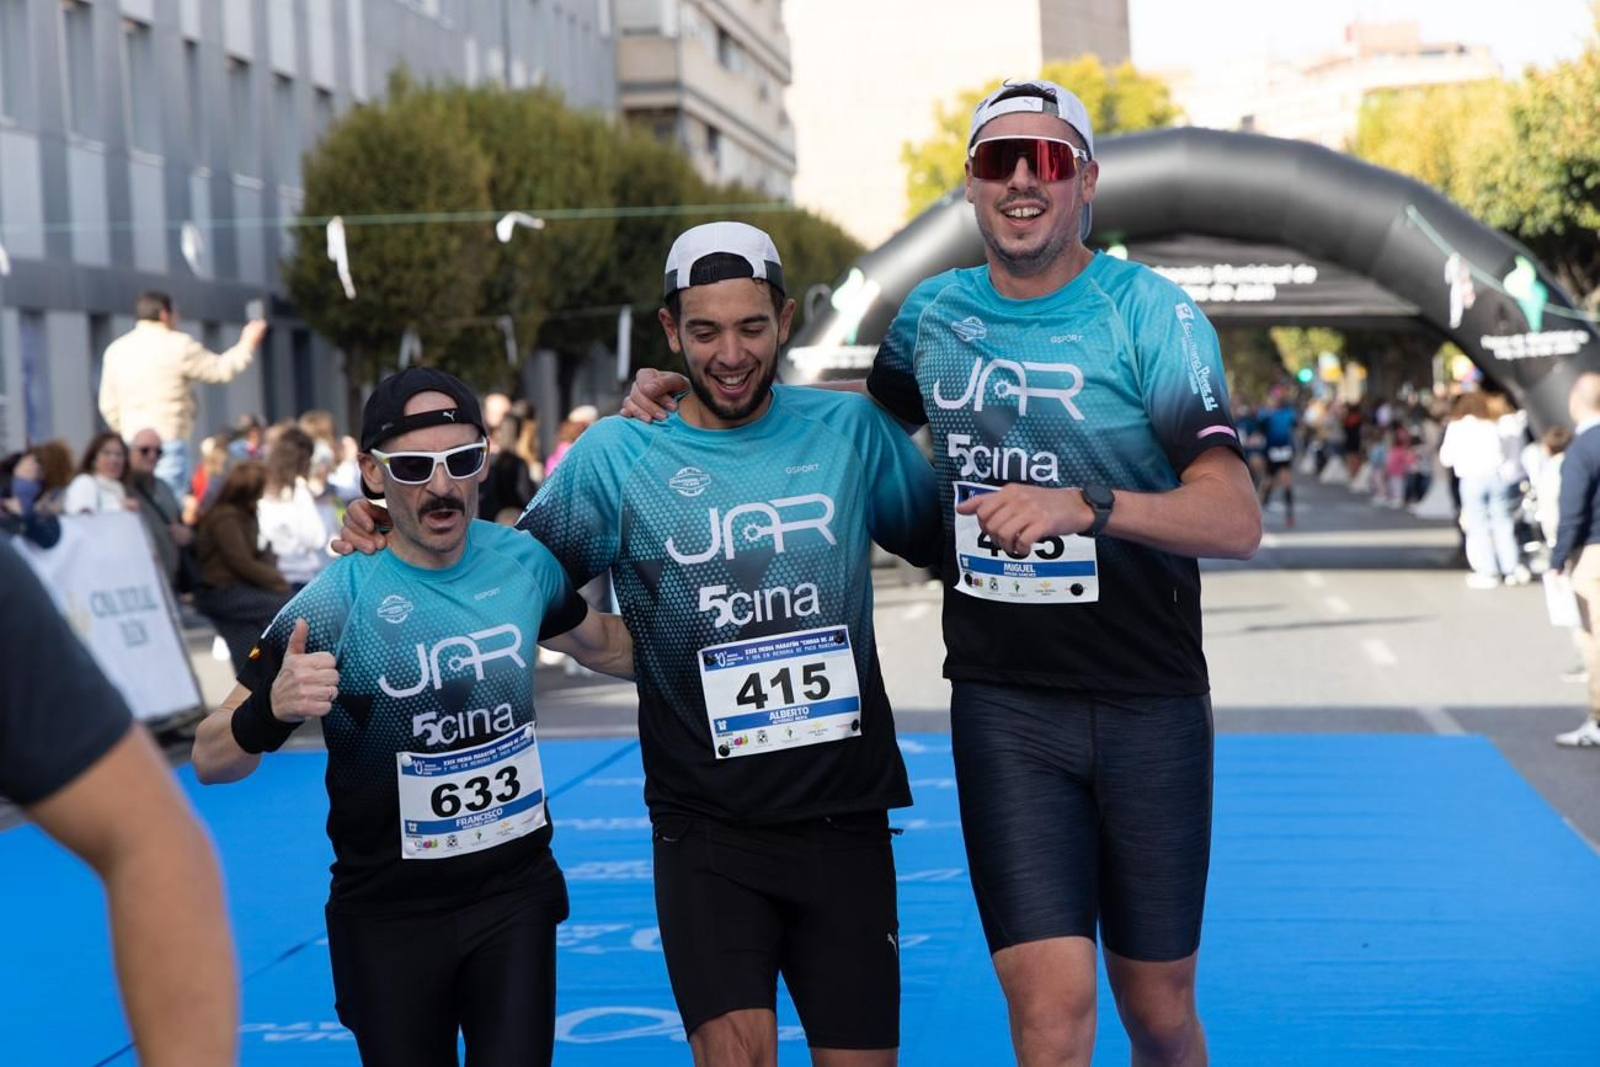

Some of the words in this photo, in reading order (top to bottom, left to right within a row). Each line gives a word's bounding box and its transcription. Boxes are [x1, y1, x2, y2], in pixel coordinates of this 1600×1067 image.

[933, 356, 1085, 421] JAR
[947, 434, 1060, 482] 5cina
[664, 493, 837, 565] JAR
[977, 529, 1065, 560] 45
[1004, 562, 1037, 573] MIGUEL
[699, 582, 821, 628] 5cina
[377, 623, 527, 699] JAR
[735, 661, 832, 710] 415
[413, 703, 516, 747] 5cina
[769, 706, 810, 721] ALBERTO
[430, 766, 521, 818] 633
[456, 807, 503, 827] FRANCISCO
